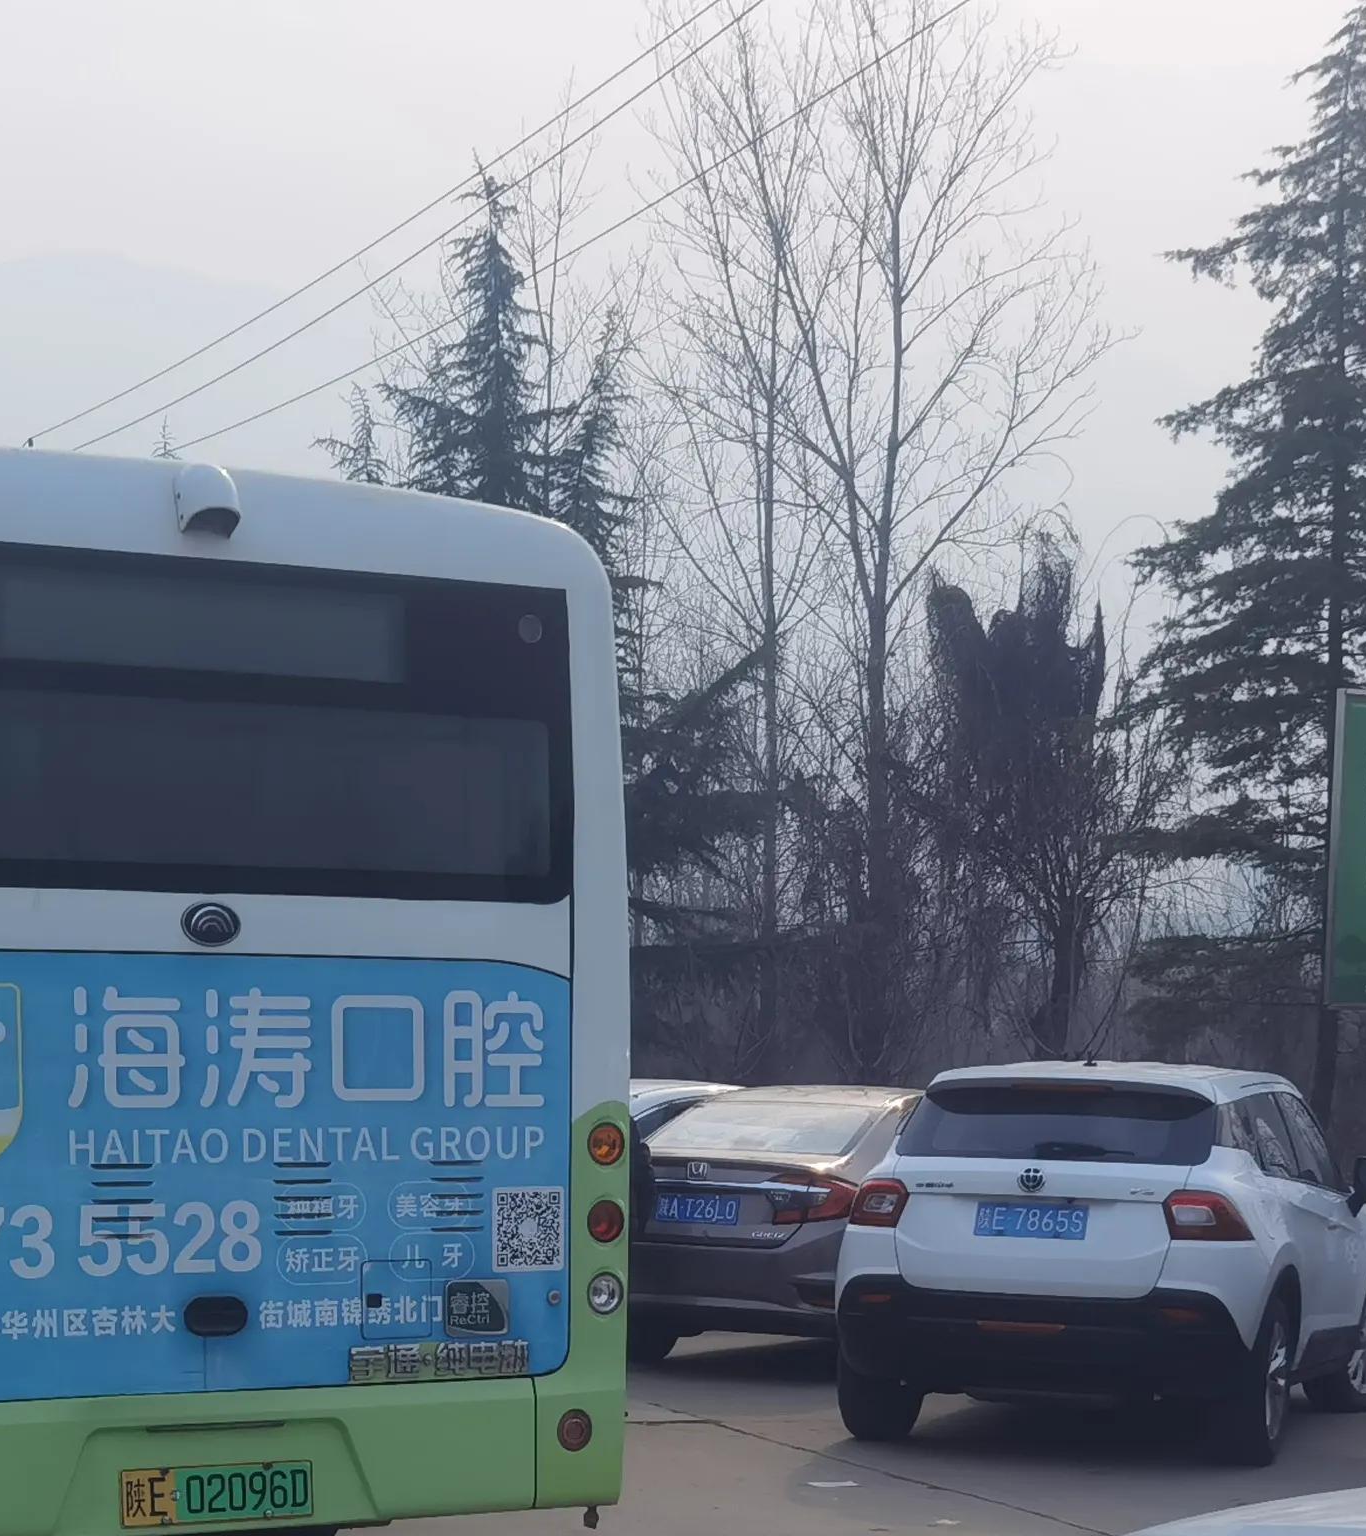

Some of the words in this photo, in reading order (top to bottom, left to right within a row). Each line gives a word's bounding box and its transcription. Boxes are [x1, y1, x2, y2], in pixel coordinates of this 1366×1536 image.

[68, 986, 545, 1108] 海涛口腔
[69, 1127, 230, 1165] HAITAO
[242, 1126, 400, 1163] DENTAL
[411, 1125, 544, 1161] GROUP
[77, 1199, 262, 1278] 5528
[285, 1246, 359, 1273] 矫正牙
[449, 1292, 490, 1315] 睿控
[449, 1313, 491, 1326] ReCtrl
